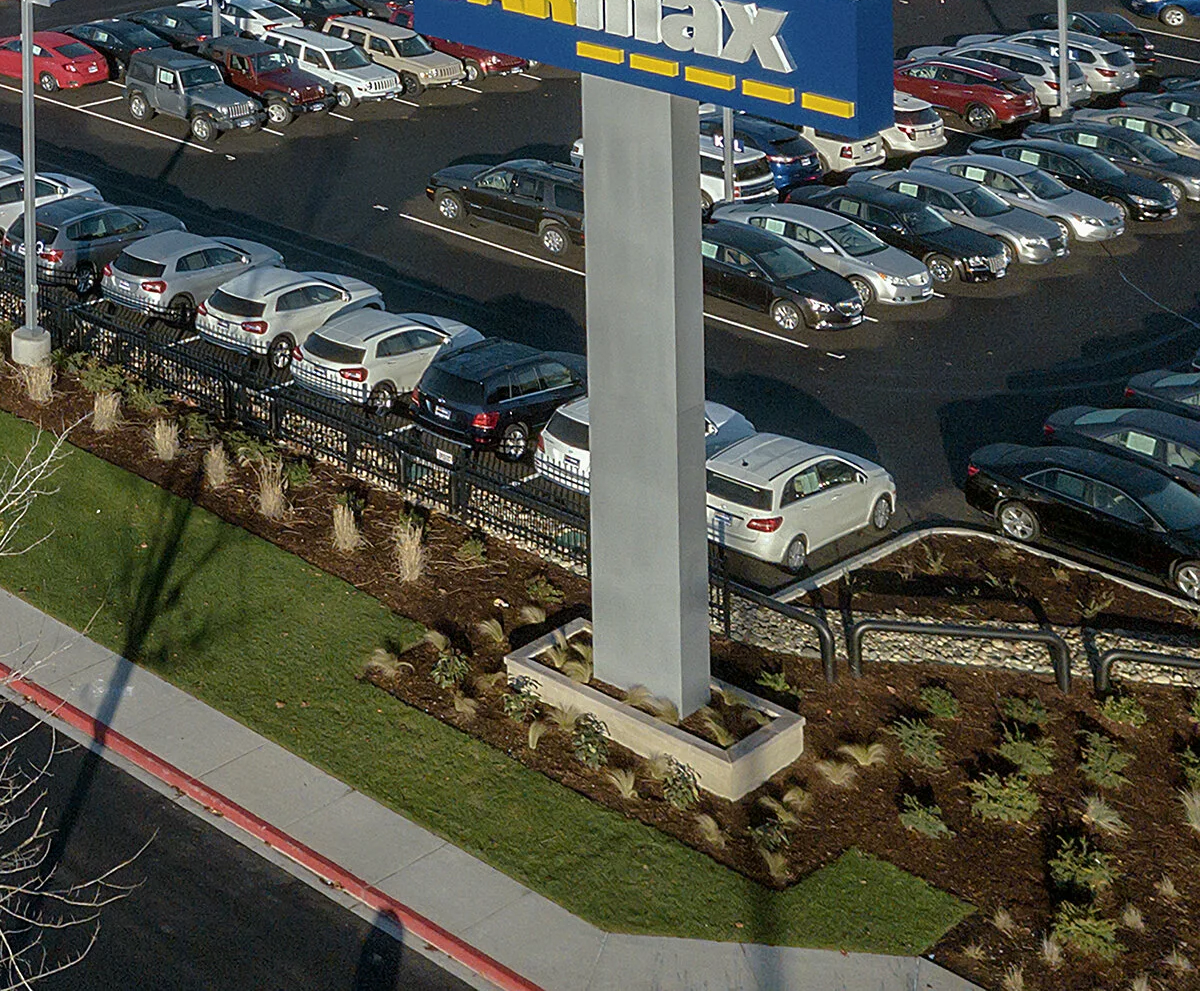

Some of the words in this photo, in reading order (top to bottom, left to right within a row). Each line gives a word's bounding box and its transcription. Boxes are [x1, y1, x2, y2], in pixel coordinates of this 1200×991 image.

[1050, 46, 1059, 57] K
[1068, 49, 1076, 60] L
[714, 134, 724, 148] K
[733, 139, 742, 152] L
